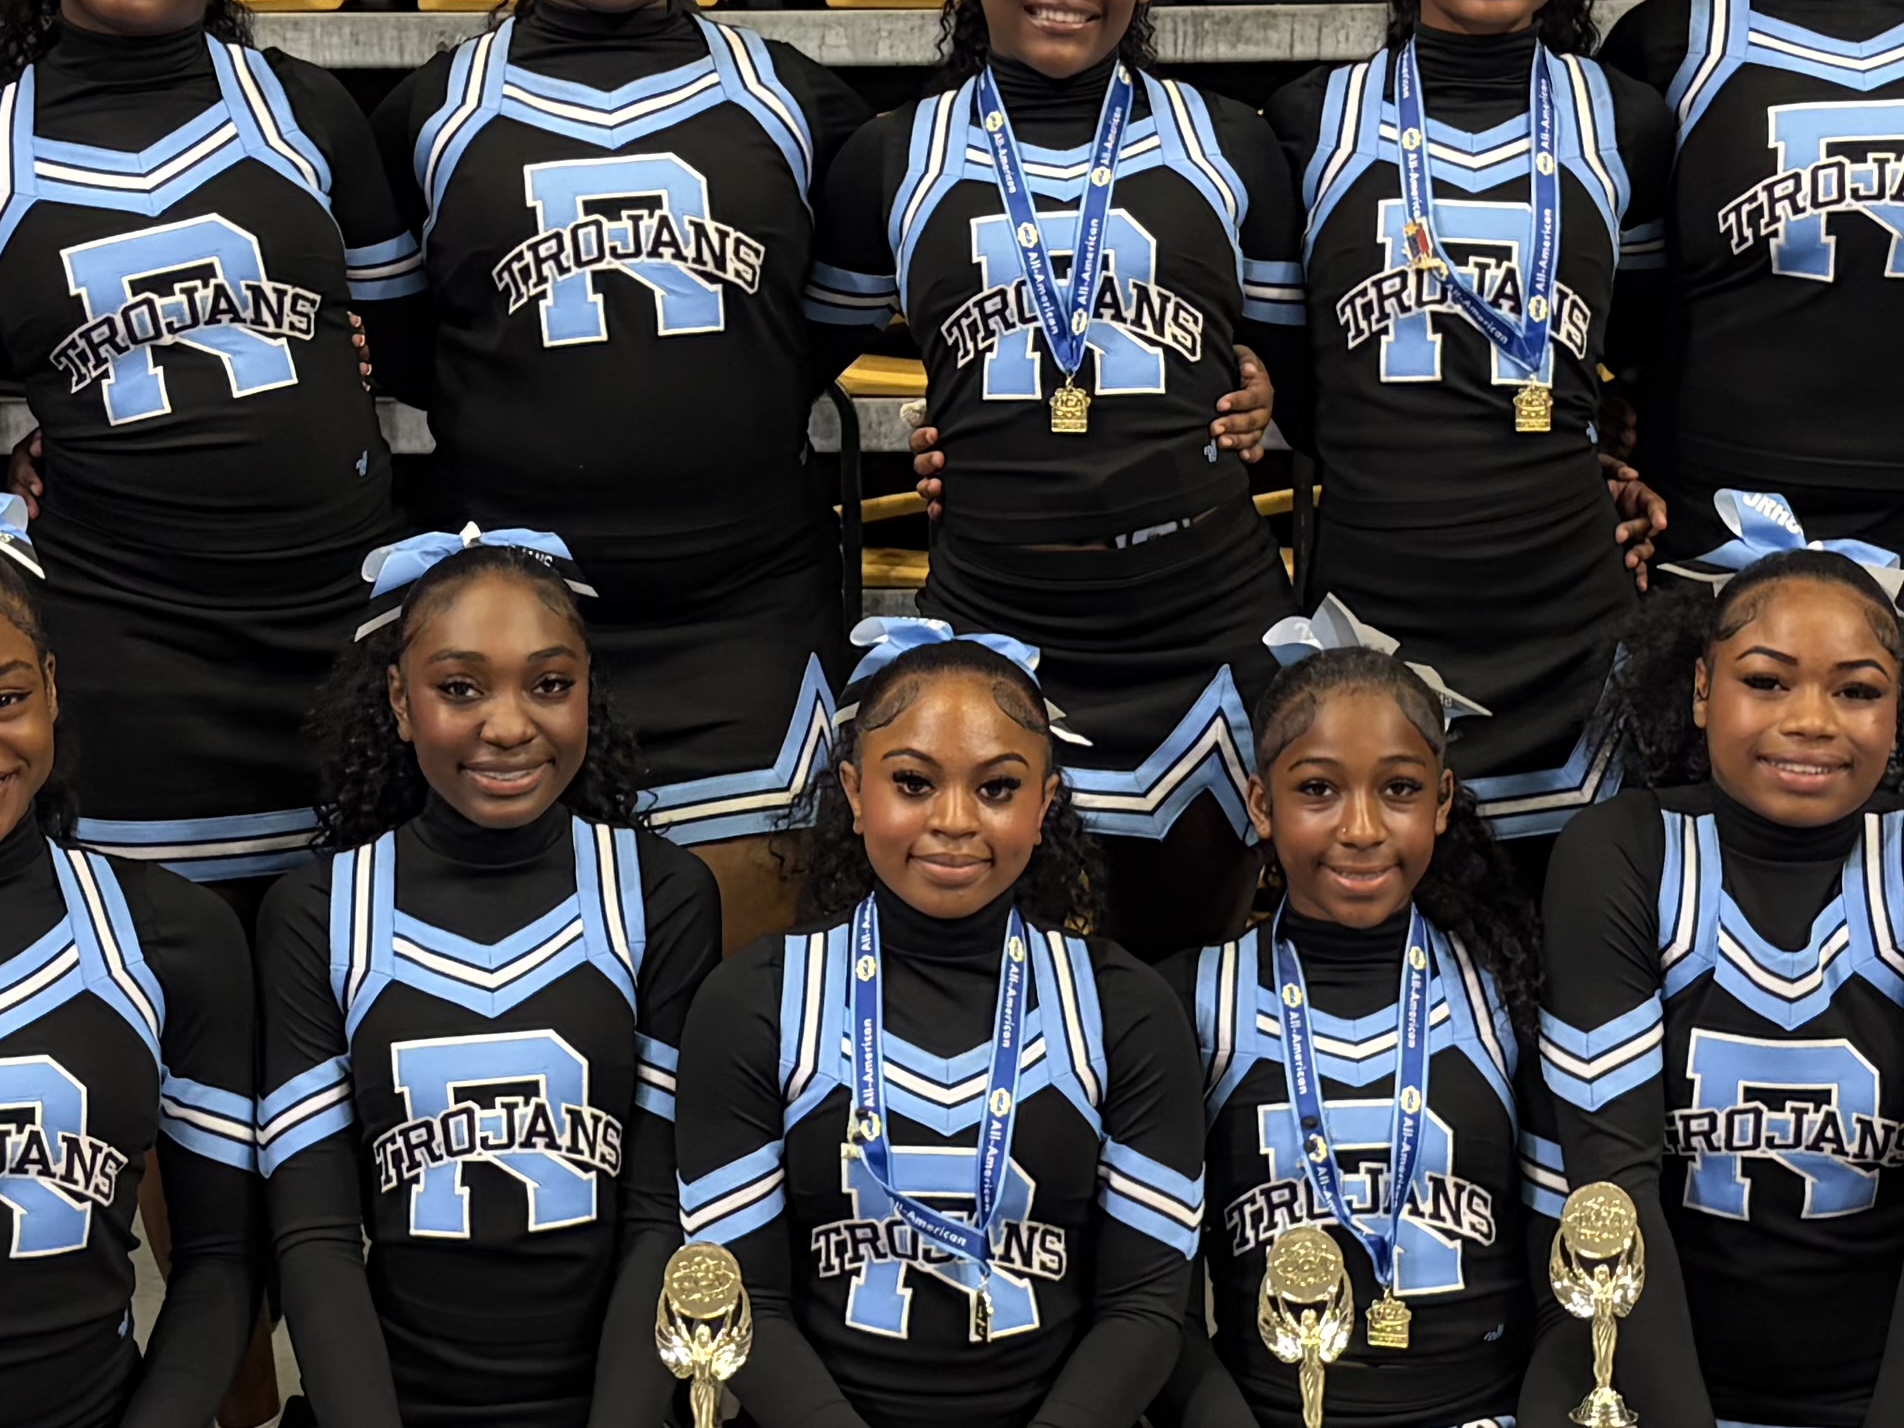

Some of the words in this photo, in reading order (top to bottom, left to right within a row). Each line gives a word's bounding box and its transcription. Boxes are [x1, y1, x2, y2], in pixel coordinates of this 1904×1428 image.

[492, 209, 766, 315] TROJANS
[524, 152, 725, 347] R
[1026, 250, 1059, 335] All-American
[1076, 218, 1100, 306] All-American
[1534, 208, 1552, 292] All-American
[49, 278, 322, 394] TROJANS
[59, 213, 298, 426] R
[1447, 283, 1509, 345] All-American
[1002, 963, 1019, 1049] All-American
[1289, 1011, 1308, 1095] All-American
[861, 1018, 874, 1108] All-American
[373, 1096, 623, 1193] TROJANS
[391, 1029, 598, 1239] R
[984, 1119, 1003, 1214] All-American
[1683, 1028, 1880, 1221] R
